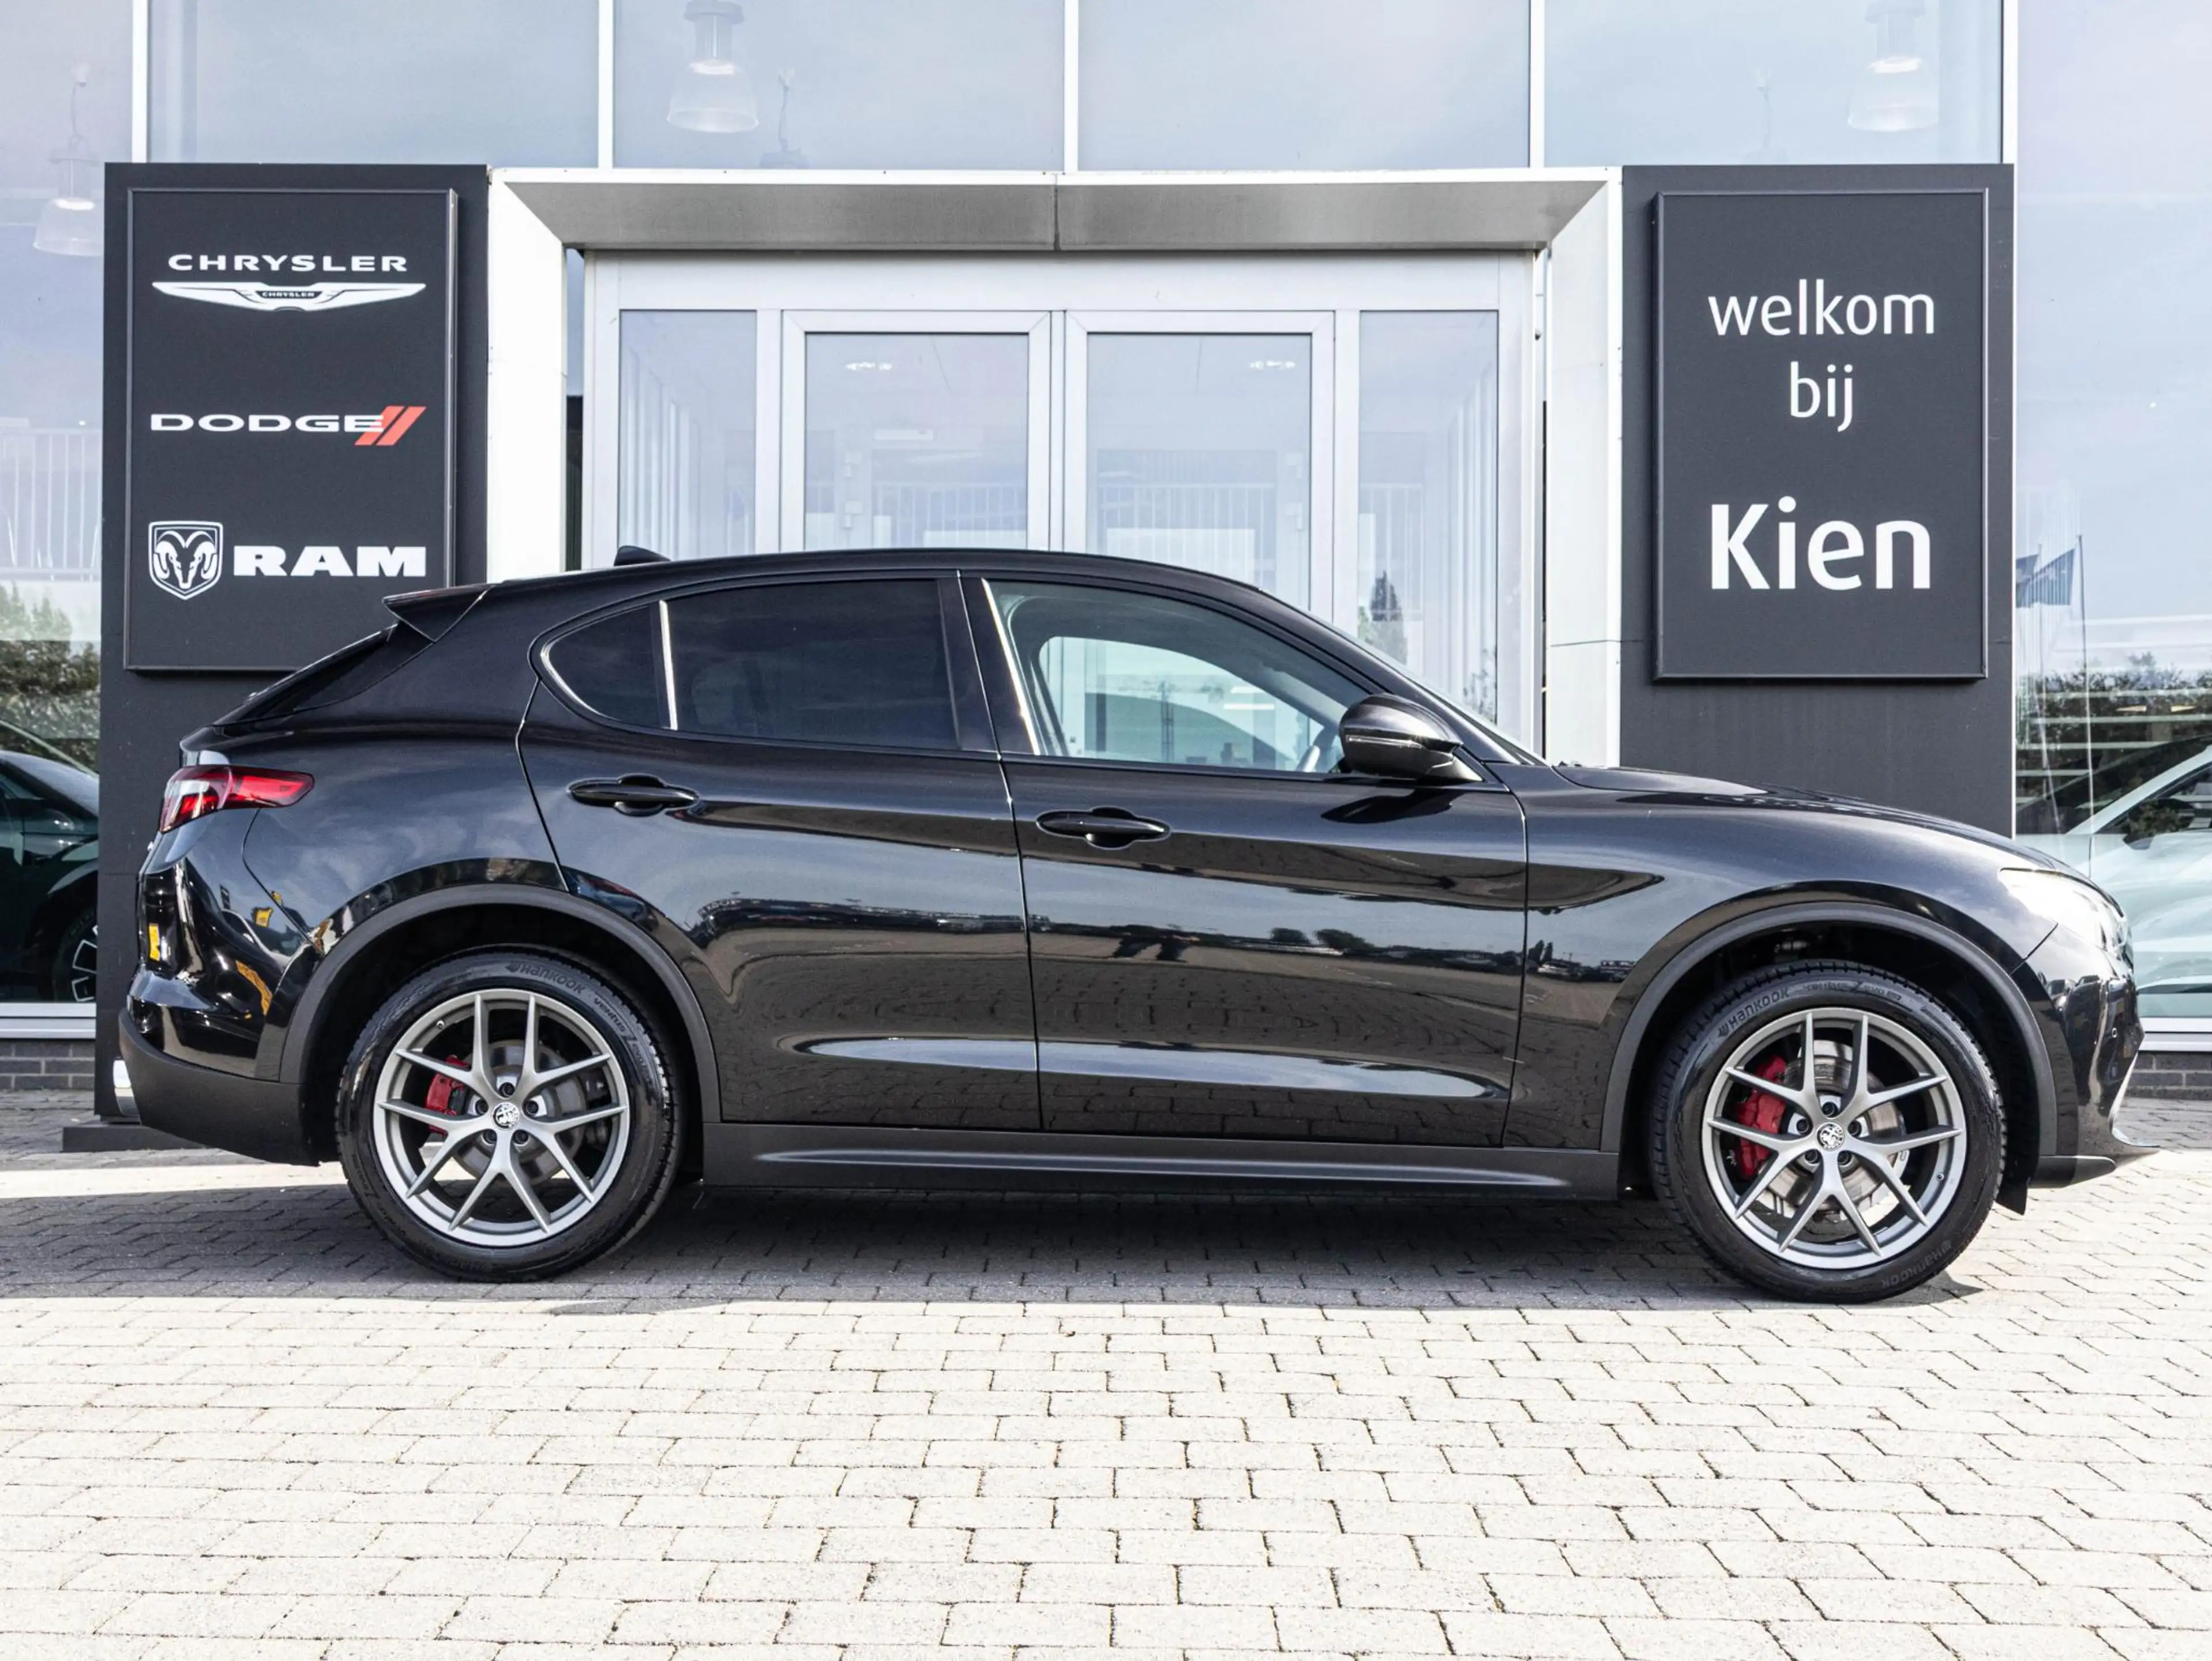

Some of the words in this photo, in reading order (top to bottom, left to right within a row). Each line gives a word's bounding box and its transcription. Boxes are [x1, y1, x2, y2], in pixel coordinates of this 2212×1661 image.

[168, 254, 407, 272] CHRYSLER
[1708, 279, 1935, 336] welkom
[1790, 360, 1853, 433] bij
[151, 414, 384, 433] DODGE
[233, 545, 427, 577] RAM
[1711, 495, 1931, 591] Kien
